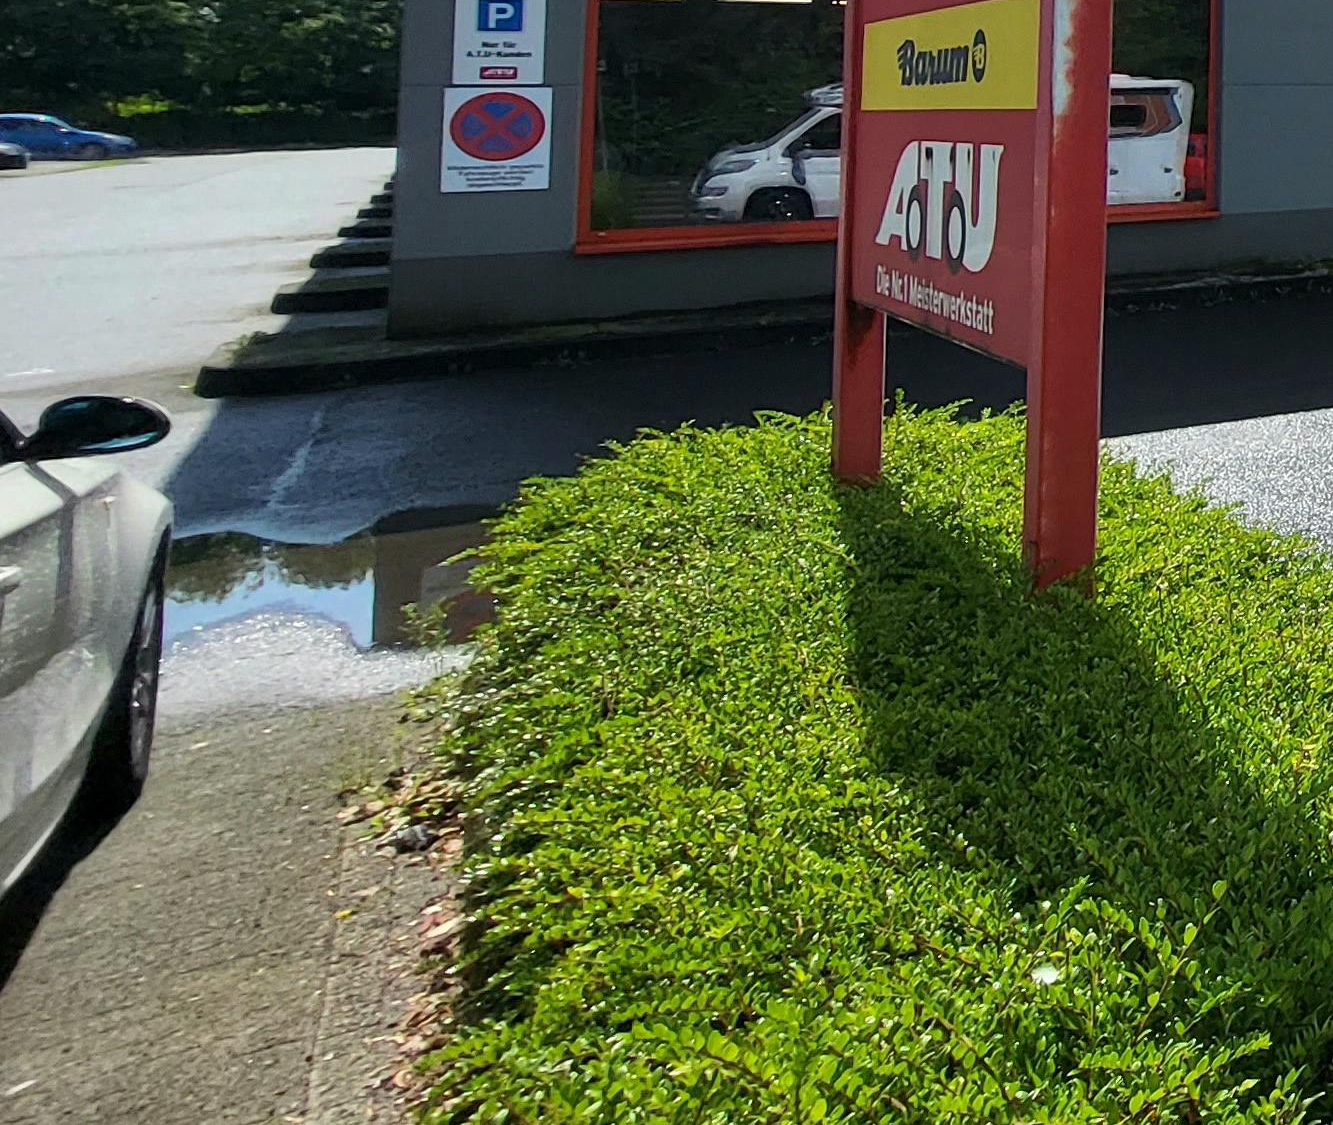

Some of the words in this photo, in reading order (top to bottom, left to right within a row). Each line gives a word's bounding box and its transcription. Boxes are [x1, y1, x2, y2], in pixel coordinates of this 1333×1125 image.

[488, 2, 515, 29] P
[897, 39, 969, 86] Barum
[875, 141, 1004, 273] ATU
[876, 265, 891, 296] Die
[909, 275, 994, 335] Meisterwerkstatt
